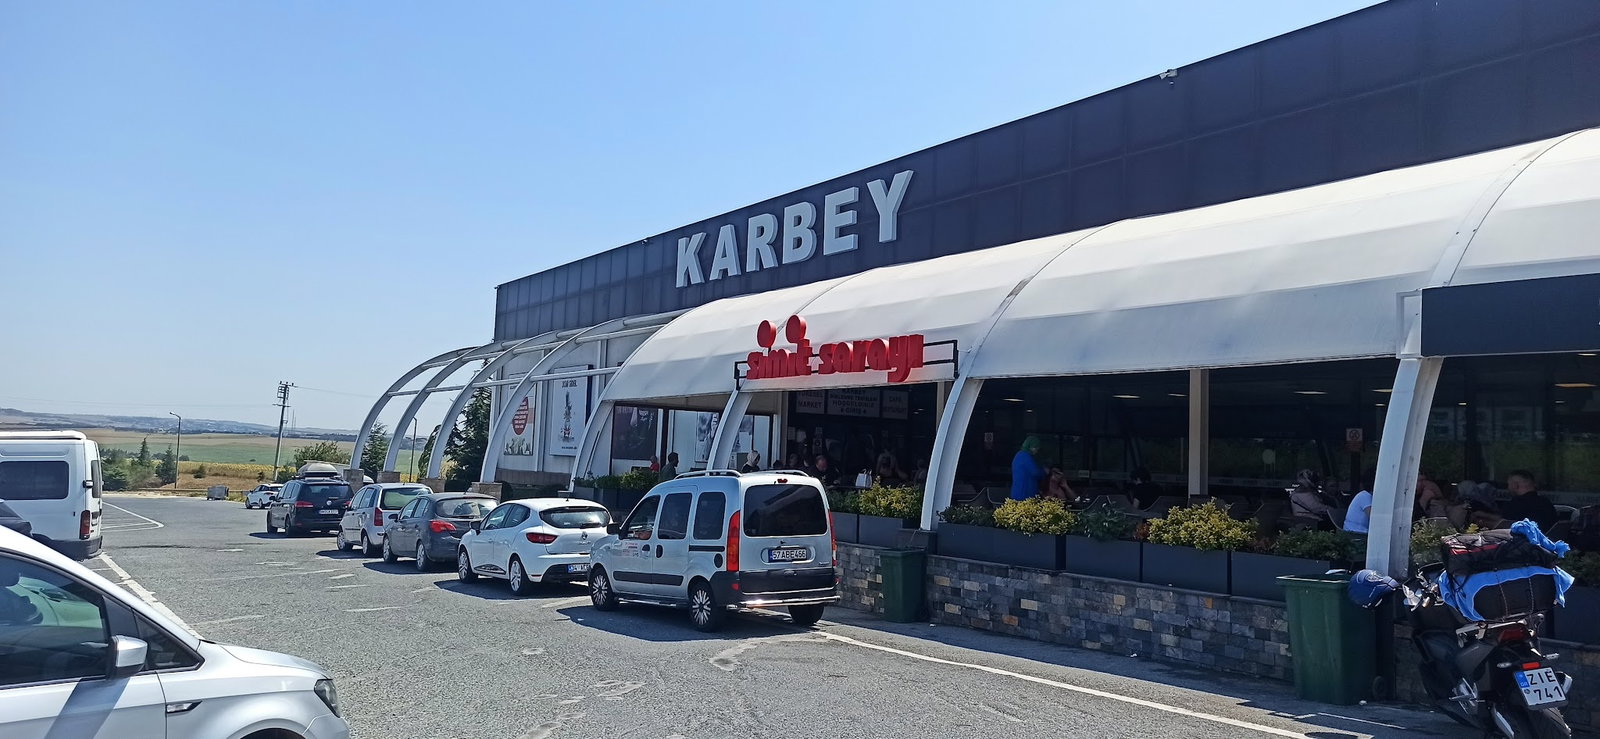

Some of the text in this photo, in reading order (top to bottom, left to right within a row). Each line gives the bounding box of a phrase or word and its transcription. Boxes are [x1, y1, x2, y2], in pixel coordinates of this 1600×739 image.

[675, 169, 915, 289] KARBEY
[746, 314, 813, 380] simit
[1526, 670, 1556, 686] ZIE
[1533, 686, 1564, 701] 741
